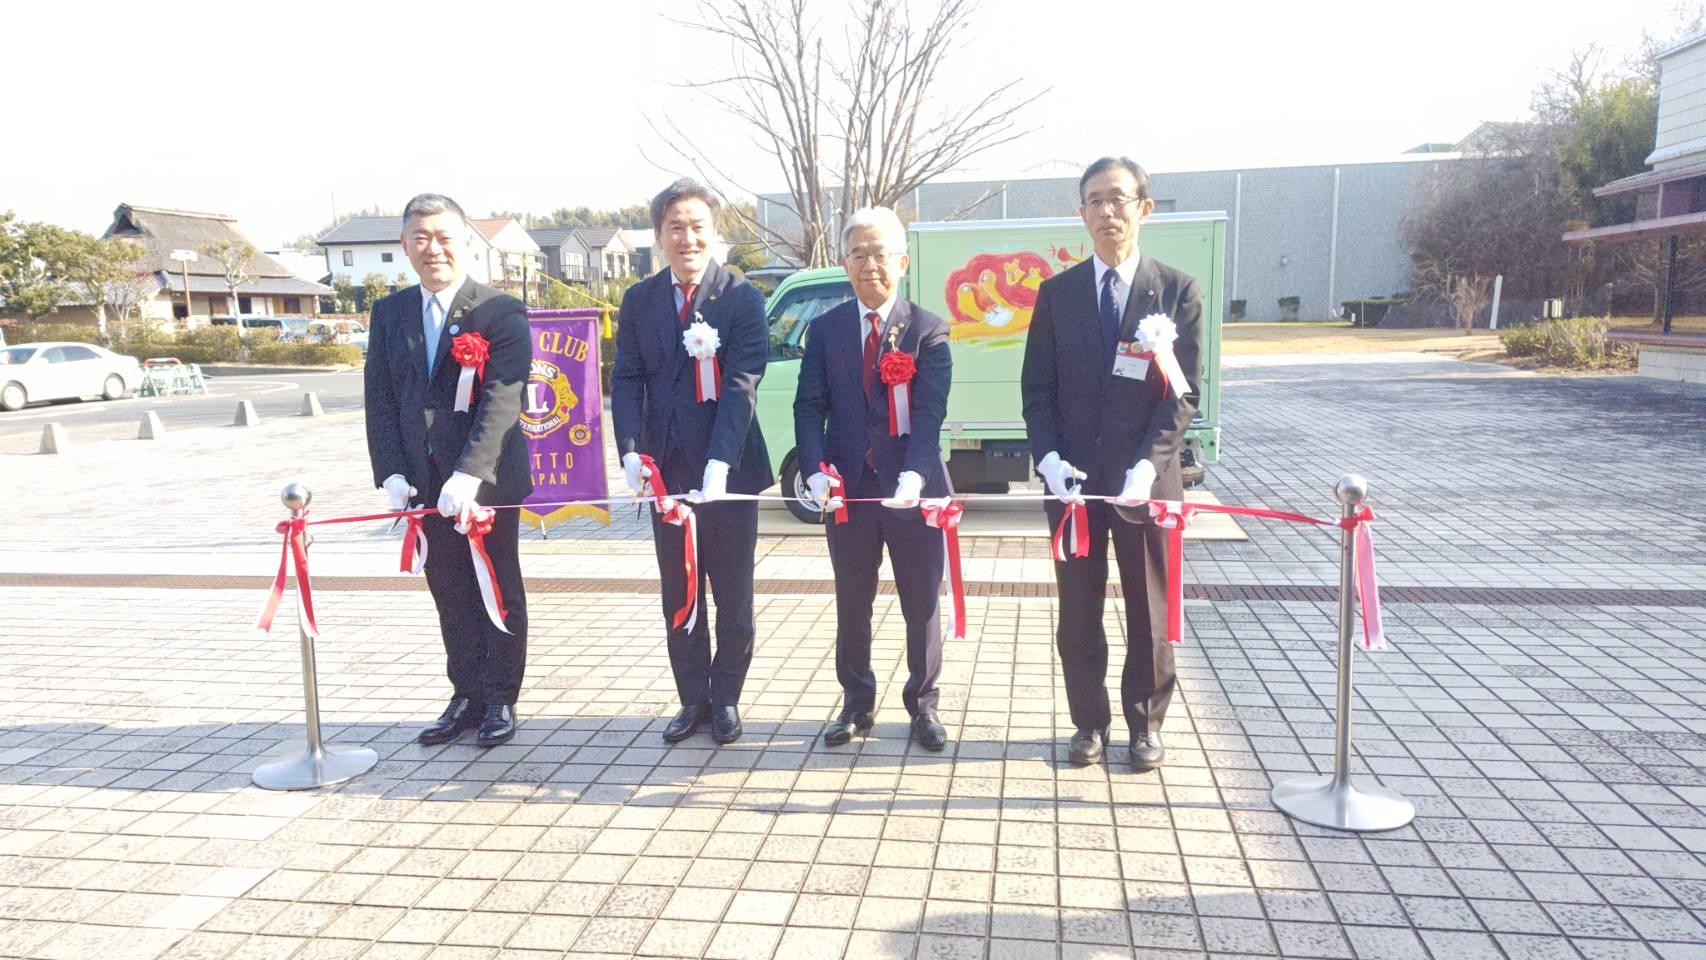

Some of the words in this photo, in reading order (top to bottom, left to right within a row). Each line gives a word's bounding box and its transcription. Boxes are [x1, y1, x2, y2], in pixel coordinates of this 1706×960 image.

[539, 331, 589, 362] CLUB
[529, 363, 556, 378] ONS
[526, 384, 549, 413] L
[519, 415, 561, 433] TERNATIONAL
[533, 452, 574, 470] TTO
[530, 472, 568, 486] APAN
